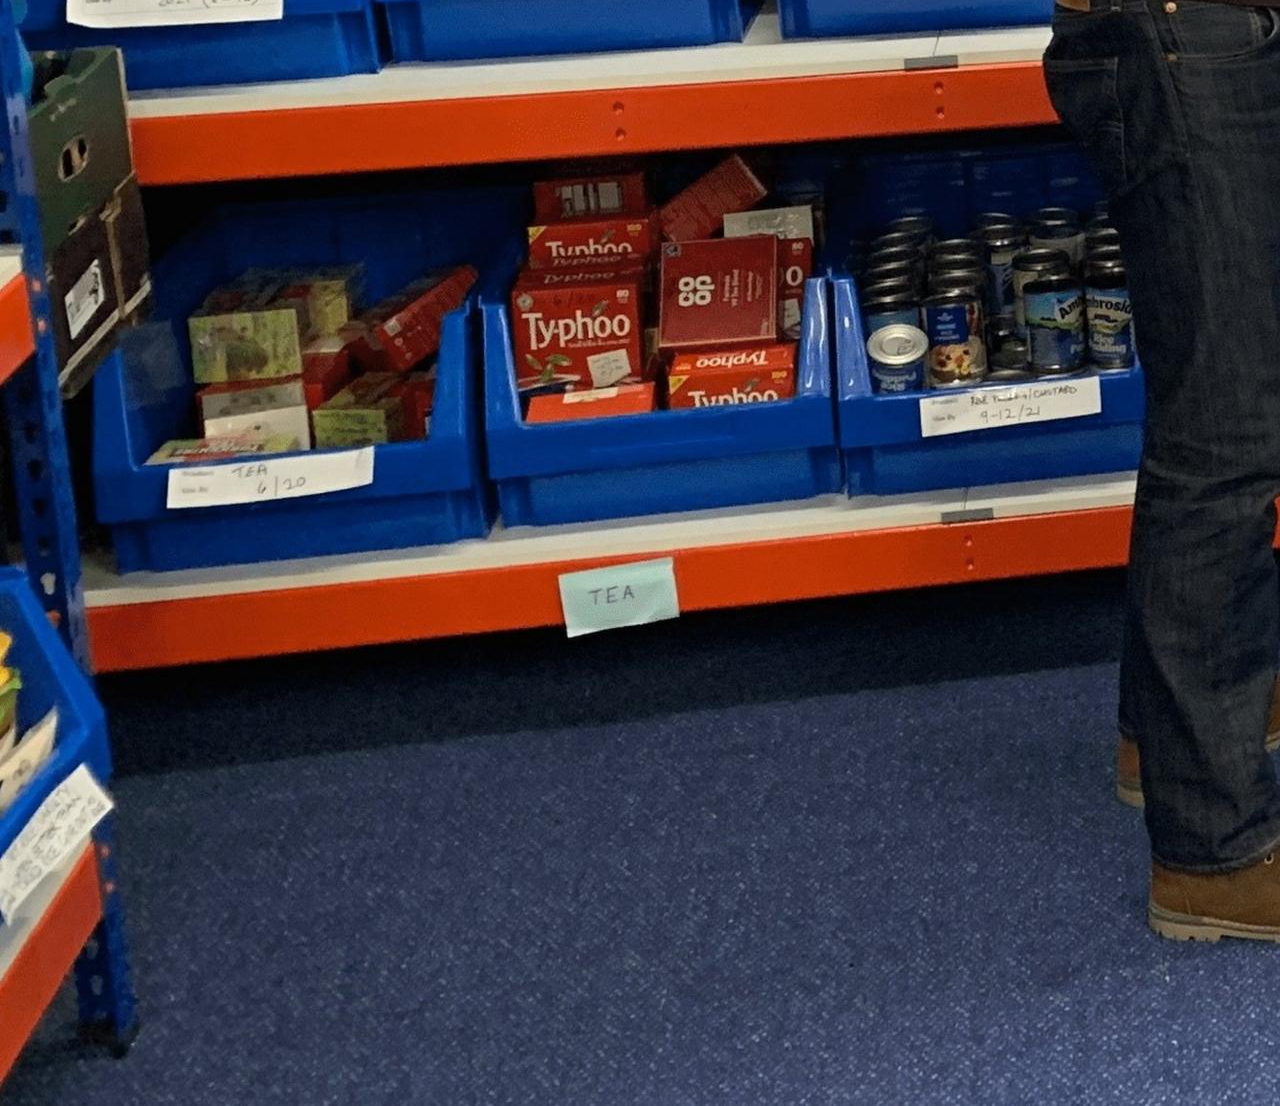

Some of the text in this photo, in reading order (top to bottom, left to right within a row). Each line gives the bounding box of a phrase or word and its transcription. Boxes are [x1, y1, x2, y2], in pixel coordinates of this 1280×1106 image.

[543, 272, 615, 284] Typhoo
[521, 310, 632, 351] Typhoo
[696, 350, 768, 369] Typhoo
[232, 463, 269, 477] TEA
[588, 584, 637, 607] TEA
